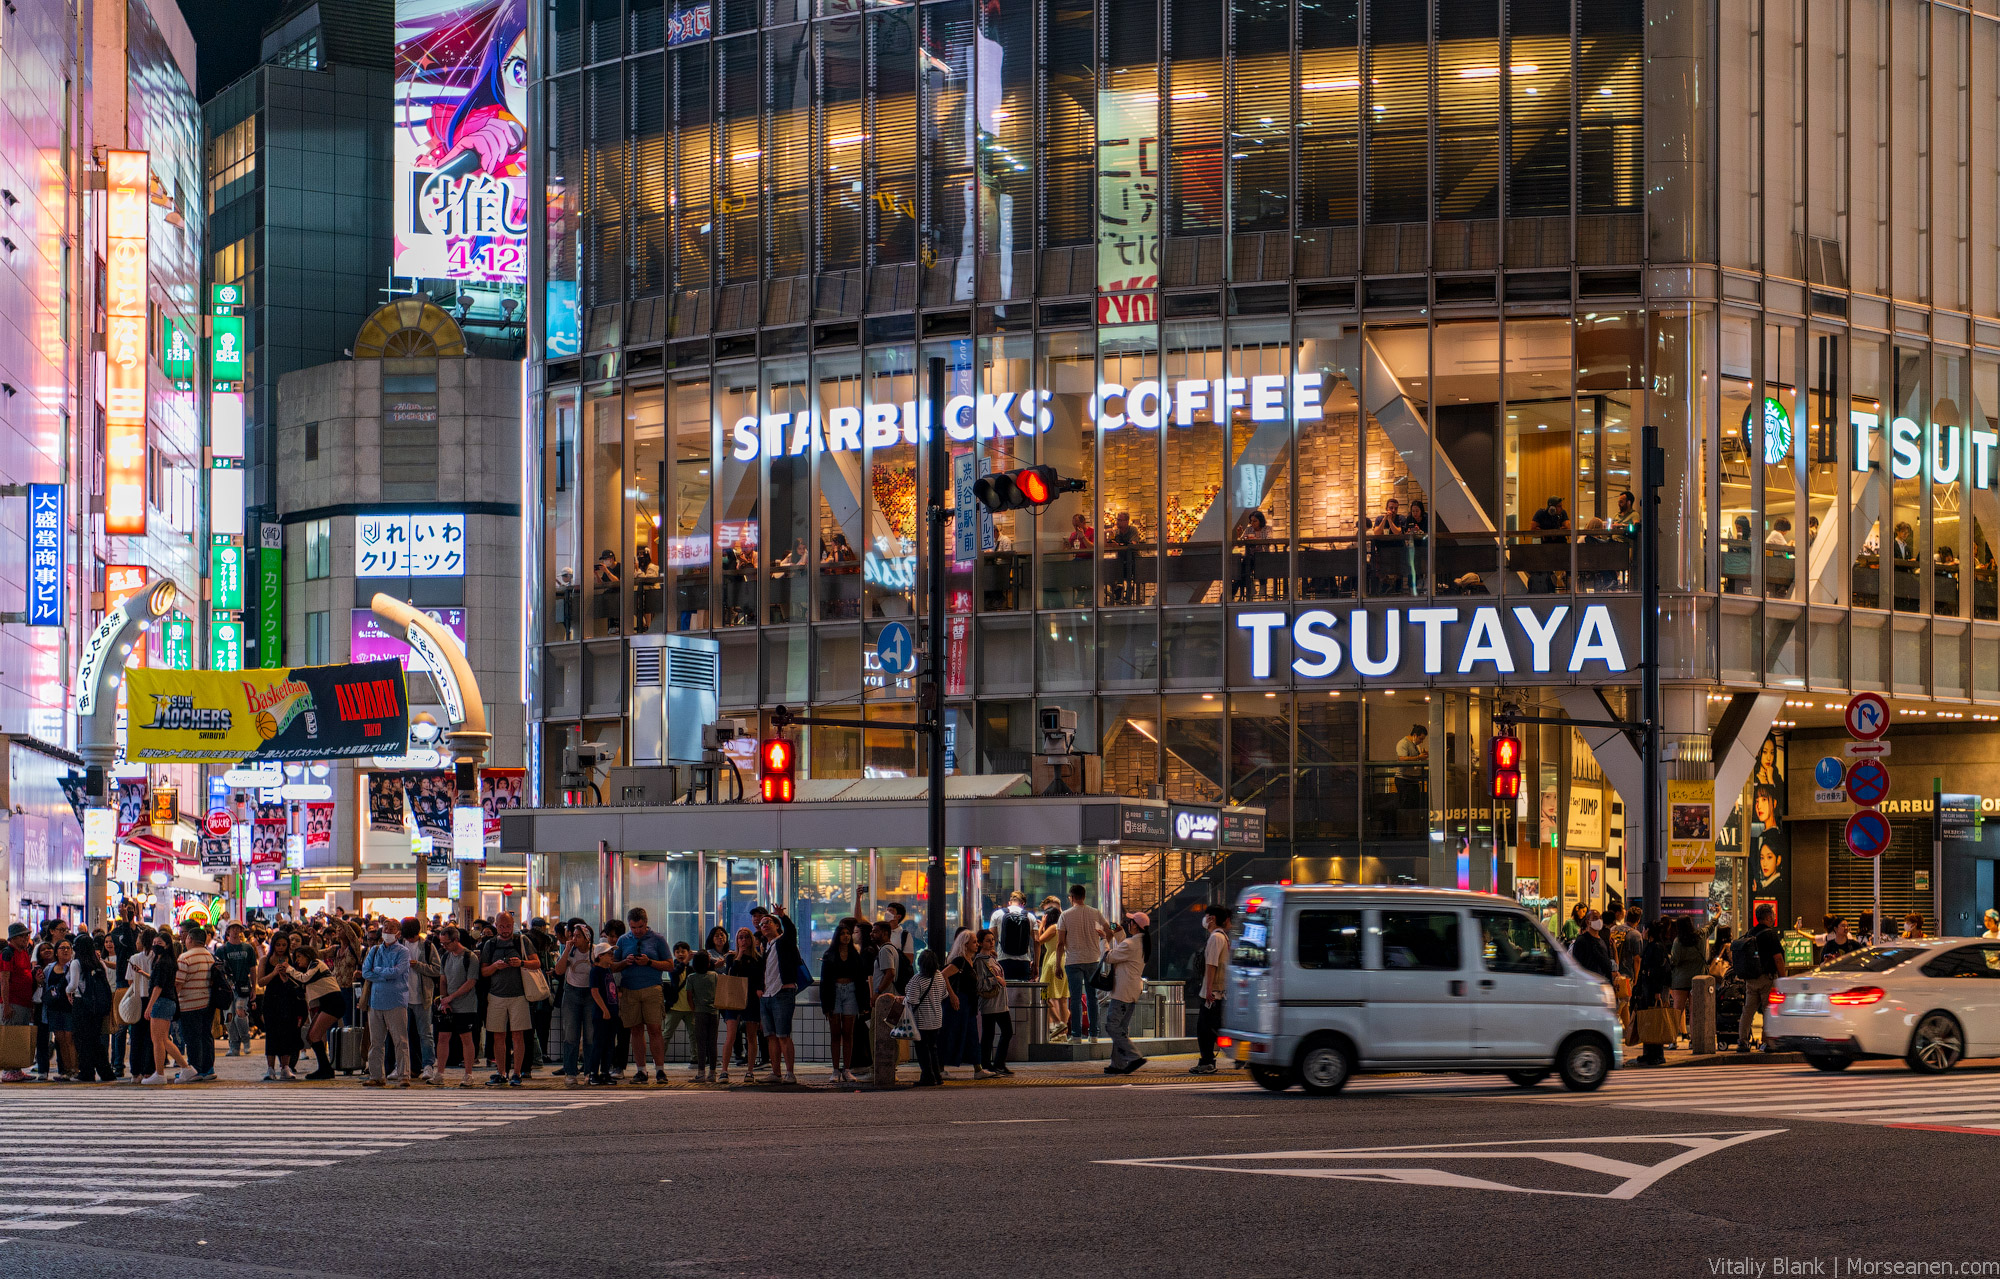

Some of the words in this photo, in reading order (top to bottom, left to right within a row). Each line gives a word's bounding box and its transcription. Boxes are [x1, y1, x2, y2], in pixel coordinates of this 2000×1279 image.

[216, 306, 229, 314] 5F
[216, 383, 229, 391] 4F
[732, 389, 1054, 461] STARBUCKS
[1090, 373, 1323, 431] COFFEE
[1851, 411, 1997, 490] TSUT
[216, 459, 229, 467] 3F
[963, 462, 974, 552] 渋谷駅前
[215, 536, 229, 544] 2F
[386, 522, 462, 545] れいわ
[34, 492, 57, 619] 大盛堂商事ビル
[361, 550, 462, 571] クリニック
[216, 612, 229, 620] 1F
[1236, 605, 1627, 679] TSUTAYA
[79, 612, 121, 712] 渋谷センター街
[410, 628, 458, 718] 渋谷センター街
[171, 695, 193, 708] SUN
[240, 680, 310, 714] Basketball
[198, 731, 226, 740] SHIBUYA
[1580, 799, 1598, 815] JUMP
[209, 817, 231, 829] 消火栓
